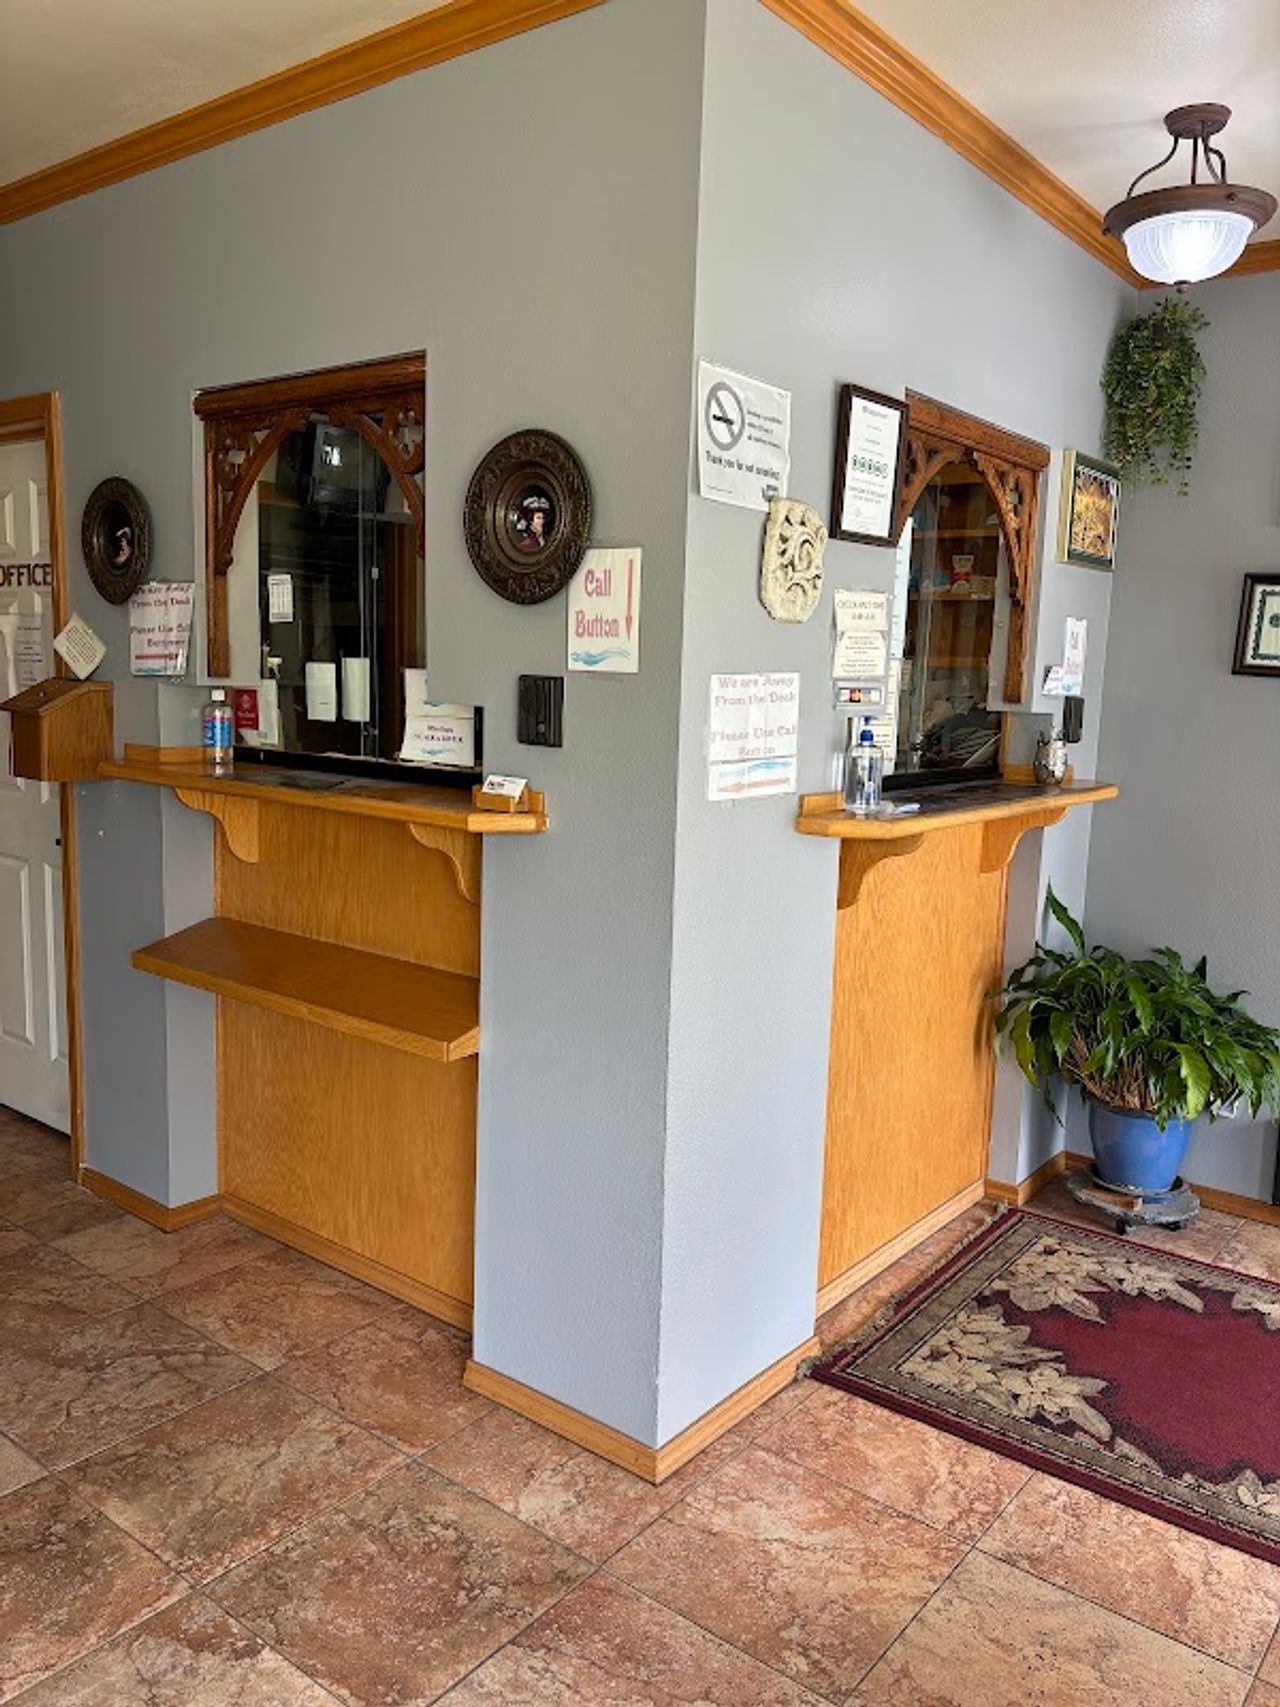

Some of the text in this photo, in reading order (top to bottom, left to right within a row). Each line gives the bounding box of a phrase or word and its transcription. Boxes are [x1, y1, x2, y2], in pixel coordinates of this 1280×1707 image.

[584, 568, 612, 597] Call
[575, 609, 620, 638] Button
[719, 677, 739, 688] We
[740, 678, 759, 687] are
[715, 691, 797, 706] From the Desk
[753, 727, 775, 739] Use
